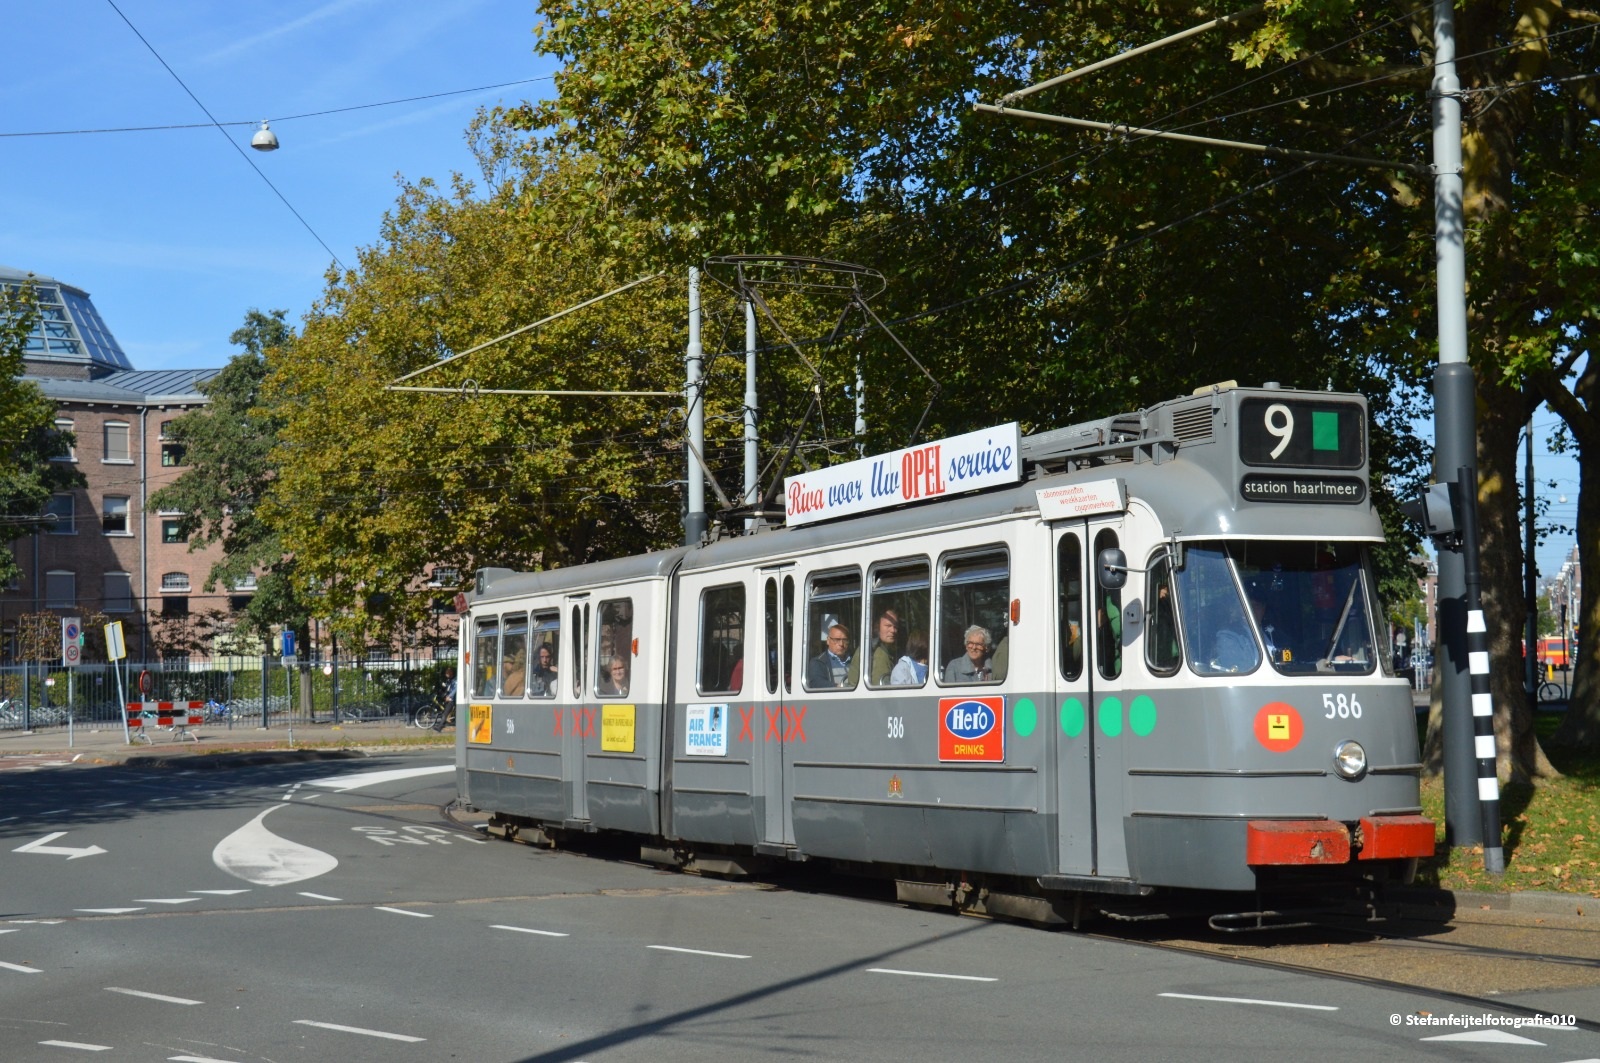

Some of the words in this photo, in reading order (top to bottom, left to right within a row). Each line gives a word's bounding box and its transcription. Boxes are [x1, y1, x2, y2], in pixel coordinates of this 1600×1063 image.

[1263, 403, 1294, 460] 9
[787, 481, 825, 516] Riva
[828, 479, 863, 506] voor
[870, 461, 900, 498] Uw
[901, 444, 946, 501] OPEL
[947, 438, 1013, 482] service
[1244, 480, 1287, 494] station
[1322, 692, 1362, 720] 586
[506, 718, 515, 734] 586
[689, 718, 705, 732] AIR
[887, 716, 904, 738] 586
[952, 704, 988, 731] Hero
[688, 733, 722, 747] FRANCE
[954, 743, 985, 756] DRINKS
